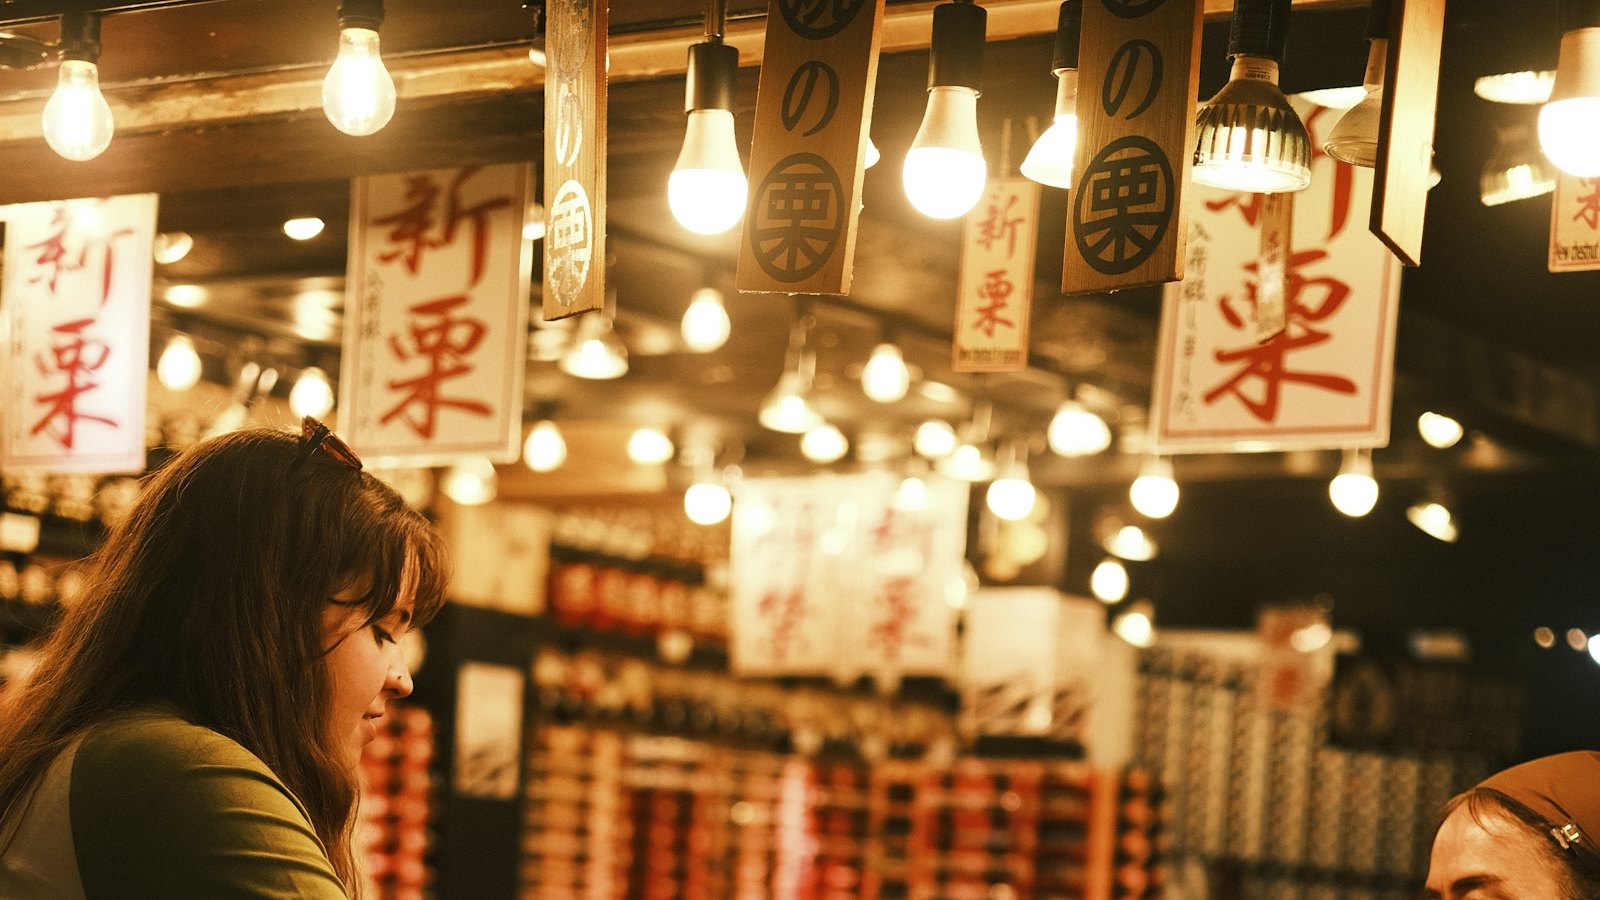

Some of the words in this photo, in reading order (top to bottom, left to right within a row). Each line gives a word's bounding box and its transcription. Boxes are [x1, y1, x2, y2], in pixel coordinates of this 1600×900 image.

[548, 0, 593, 305] の栗
[974, 194, 1025, 338] 新栗
[1073, 0, 1175, 275] の栗
[372, 163, 511, 440] 新栗
